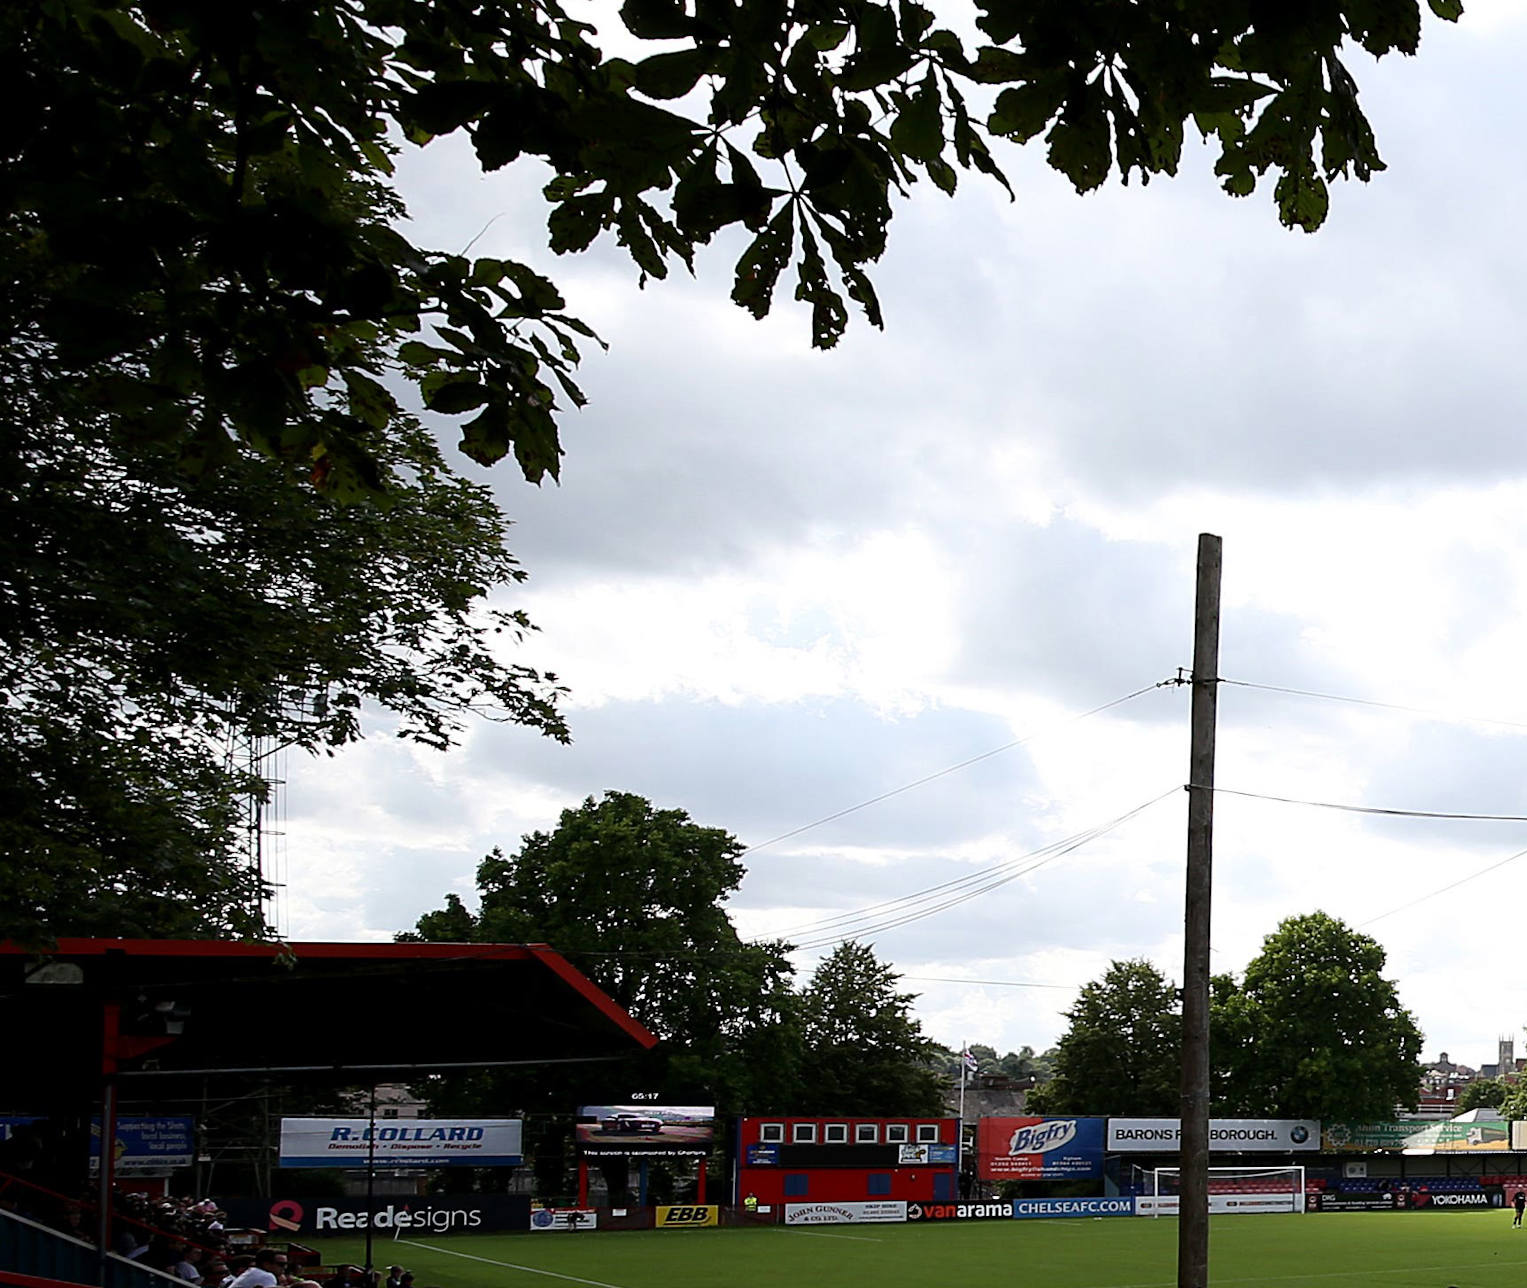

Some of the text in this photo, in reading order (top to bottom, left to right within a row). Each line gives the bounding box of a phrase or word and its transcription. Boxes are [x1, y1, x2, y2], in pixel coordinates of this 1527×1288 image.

[330, 1127, 484, 1141] R.COLLARD
[1115, 1129, 1278, 1140] BARONS FBOROUGH.
[1383, 1124, 1430, 1134] Transport
[1013, 1121, 1074, 1152] Bigfry
[390, 1143, 433, 1151] Dispose
[443, 1143, 483, 1151] Recycle
[1431, 1194, 1488, 1205] YOKOHAMA
[788, 1207, 814, 1222] JOHN
[815, 1204, 854, 1221] GUNNER
[923, 1204, 1013, 1219] vanarama
[1018, 1201, 1131, 1214] CHELSEAFC.COM
[664, 1207, 709, 1223] EBB
